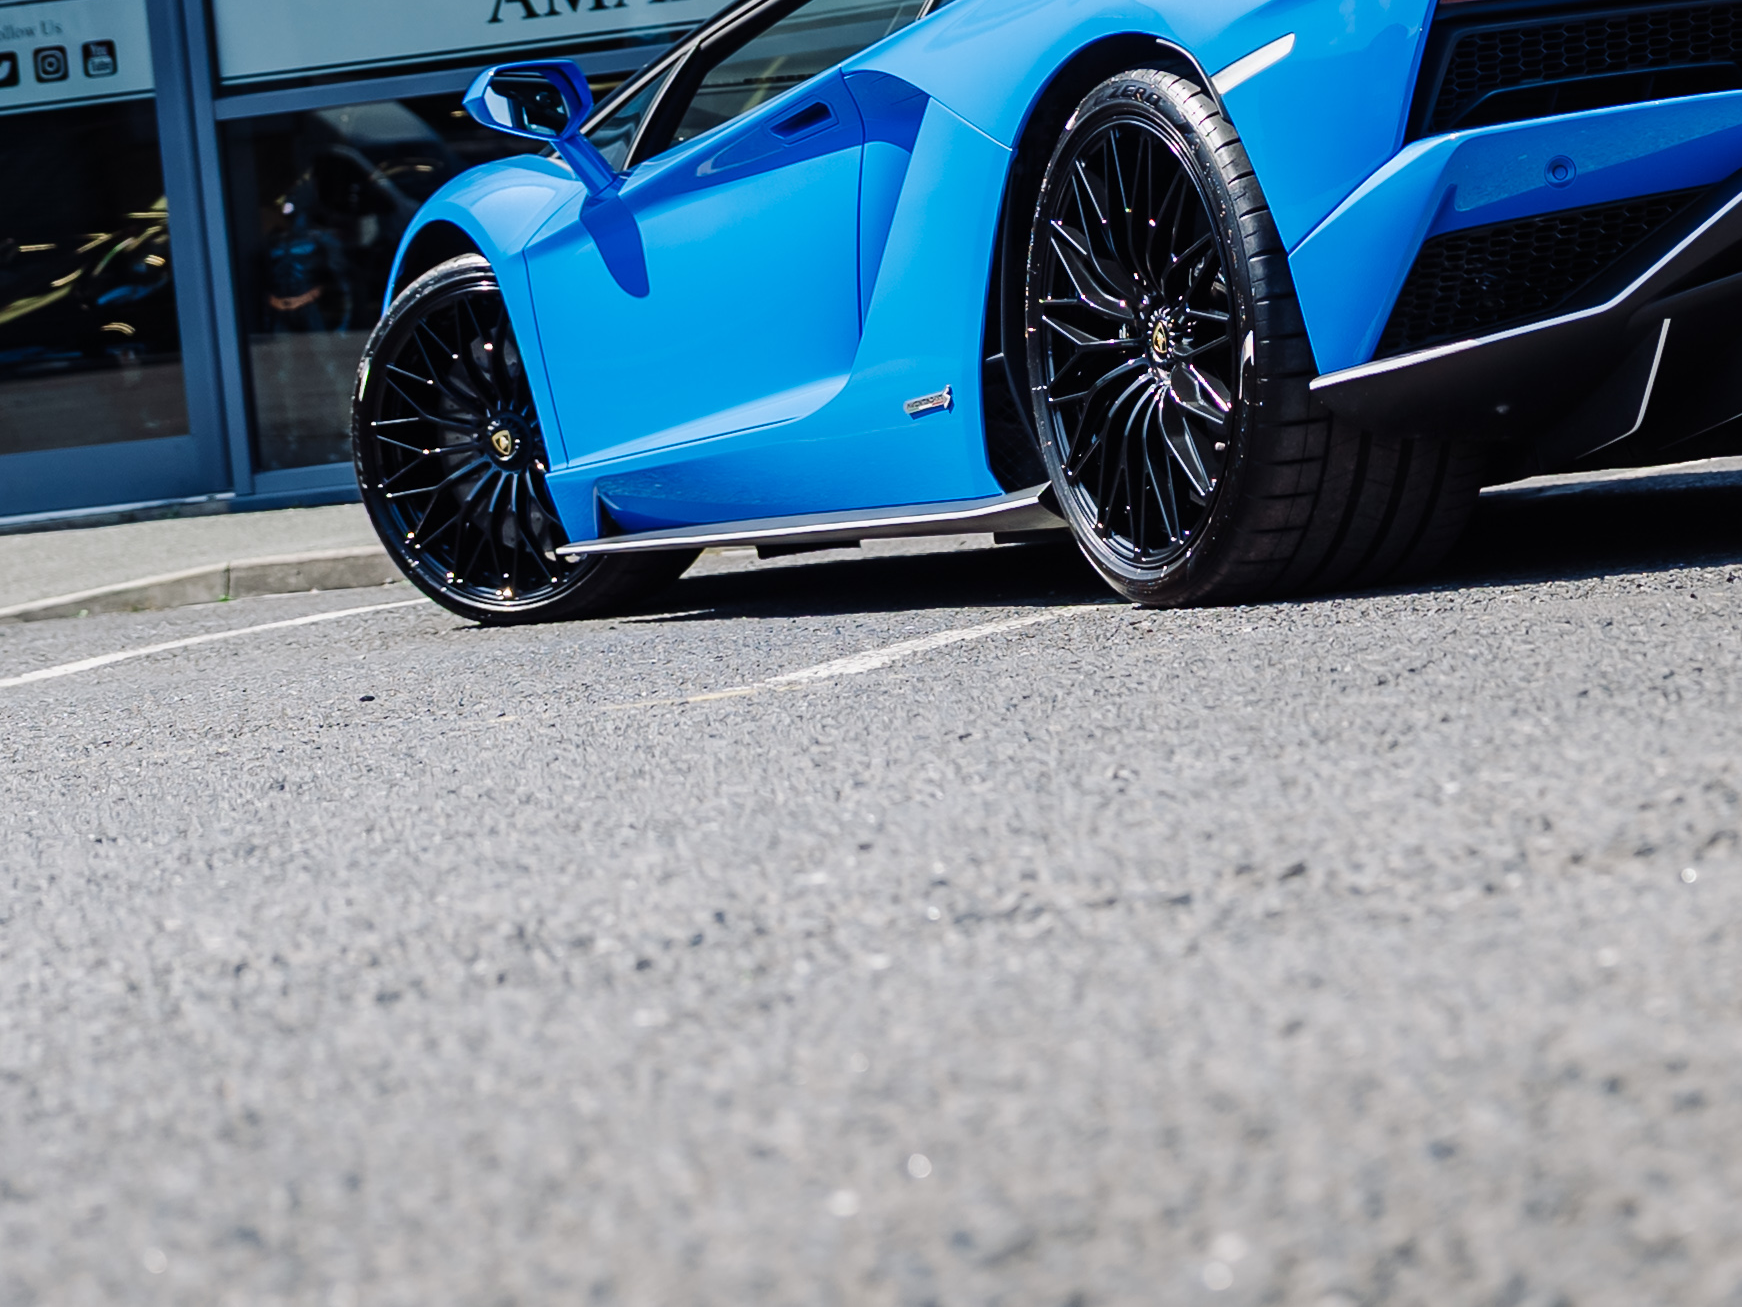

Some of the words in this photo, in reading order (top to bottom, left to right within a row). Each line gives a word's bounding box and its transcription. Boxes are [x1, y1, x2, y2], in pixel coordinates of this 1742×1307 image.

[0, 24, 36, 41] ollow
[40, 20, 63, 37] Us
[1107, 84, 1162, 108] ZERO
